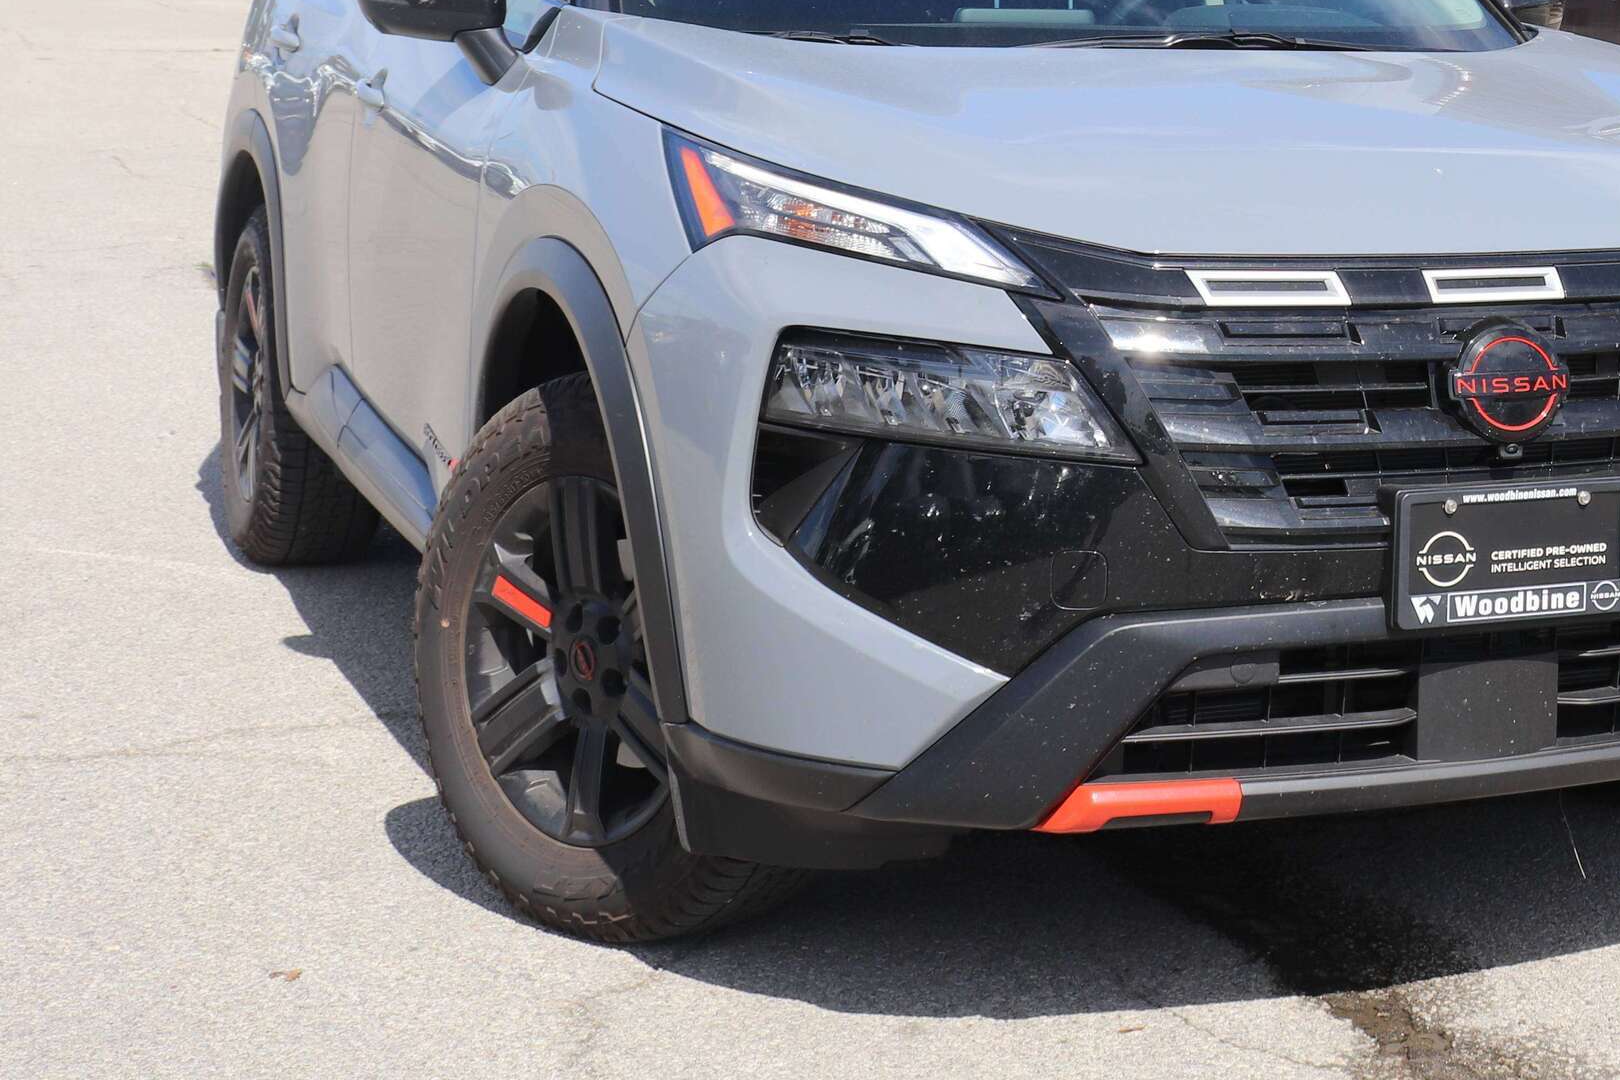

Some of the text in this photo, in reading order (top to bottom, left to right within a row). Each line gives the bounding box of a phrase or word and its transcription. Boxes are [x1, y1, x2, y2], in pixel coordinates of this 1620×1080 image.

[1456, 374, 1567, 393] NISSAN
[1462, 487, 1577, 504] www.woodbinenissan.com
[1416, 552, 1477, 566] NISSAN
[1491, 542, 1607, 561] CERTIFIED PRE-OWNED
[1491, 555, 1606, 573] INTELLIGENT SELECTION
[1454, 589, 1580, 617] Woodbine
[1590, 591, 1620, 600] NISSAN
